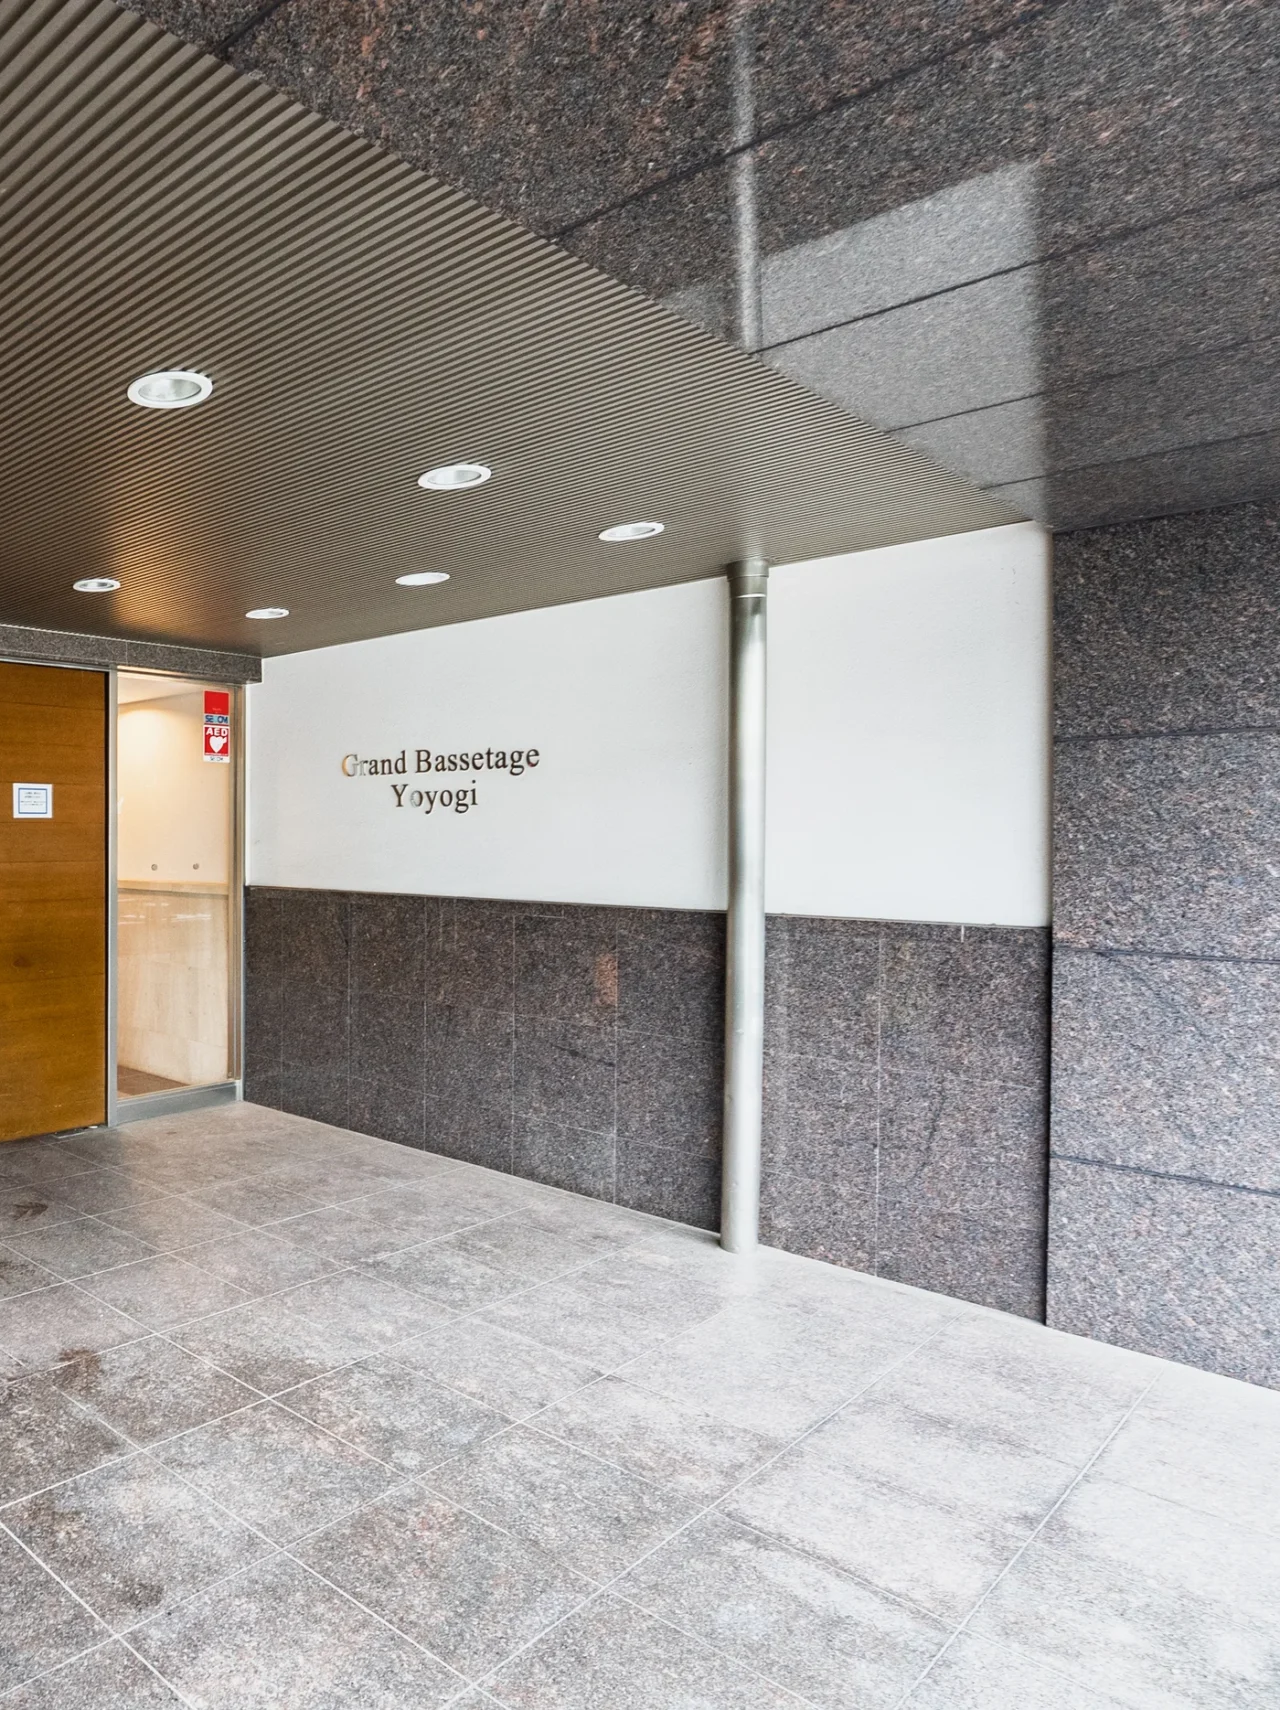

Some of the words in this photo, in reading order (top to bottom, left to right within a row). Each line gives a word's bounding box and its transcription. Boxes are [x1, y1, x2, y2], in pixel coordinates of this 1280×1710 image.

[205, 714, 228, 724] SEOM
[206, 727, 228, 737] AED
[341, 750, 407, 777] Grand
[415, 747, 540, 776] Bassetage
[391, 780, 478, 814] Yoyogi
